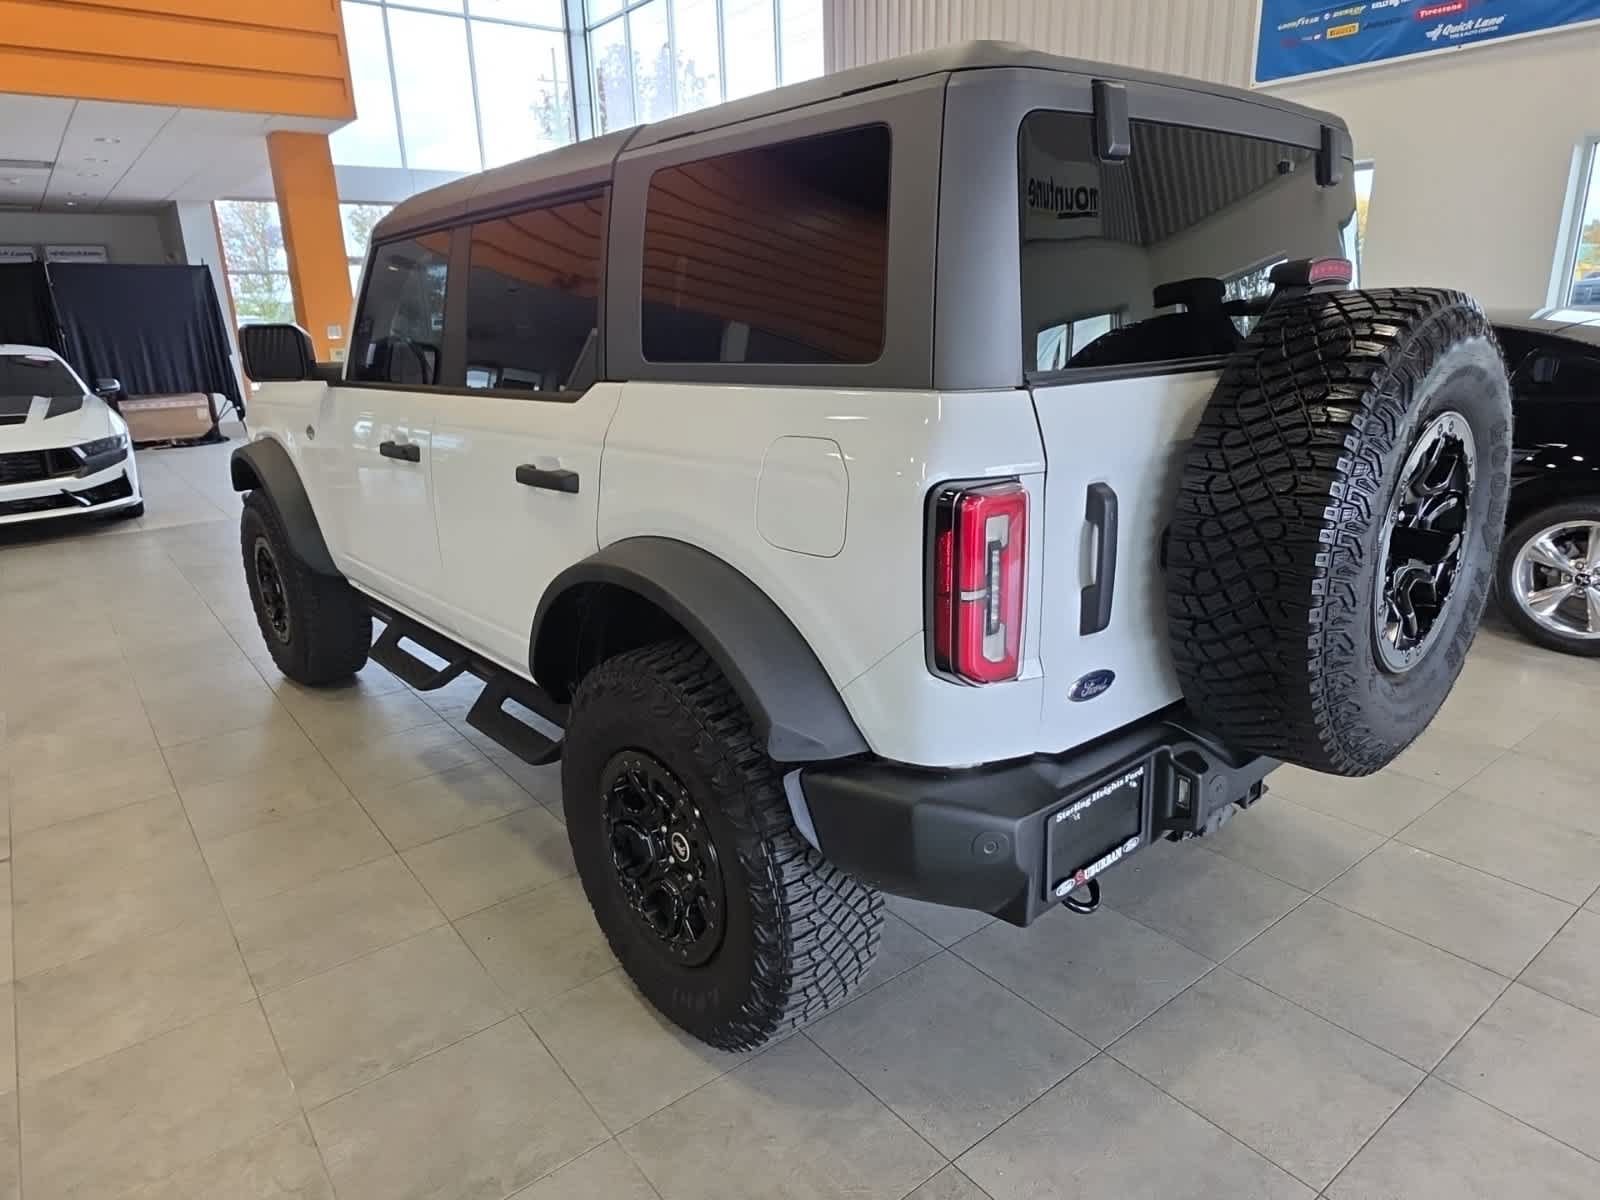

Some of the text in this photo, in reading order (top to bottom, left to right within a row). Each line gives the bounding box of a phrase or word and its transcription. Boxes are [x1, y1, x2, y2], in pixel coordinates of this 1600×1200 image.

[1442, 16, 1505, 36] Quick Lane
[1056, 766, 1144, 823] Sterling Heights Ford
